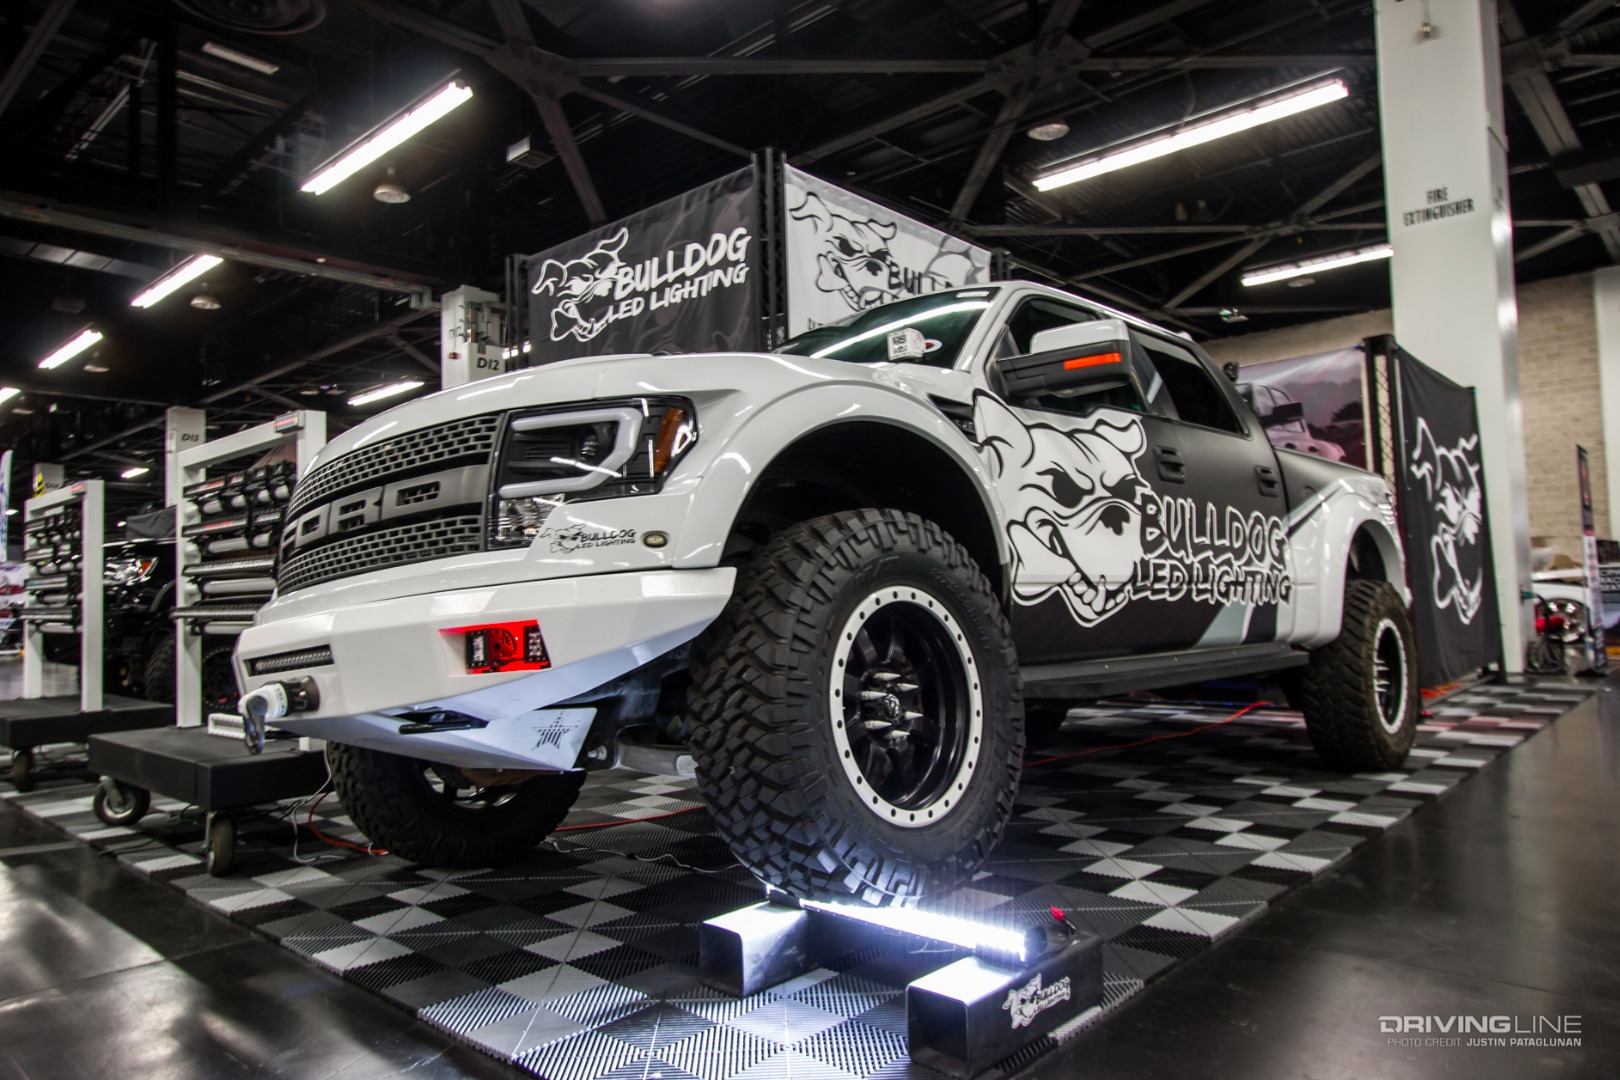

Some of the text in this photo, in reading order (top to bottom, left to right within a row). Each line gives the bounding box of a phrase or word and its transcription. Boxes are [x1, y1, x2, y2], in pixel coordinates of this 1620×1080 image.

[1403, 198, 1475, 227] EXTINGUISHER
[1427, 187, 1448, 204] FIRE
[614, 227, 752, 300] BULLDOG
[600, 263, 750, 325] LED LIGHTING
[477, 357, 500, 371] D12
[280, 466, 462, 558] FORD
[1136, 487, 1290, 567] BULLDOG
[580, 529, 637, 542] BULLDOG
[595, 538, 636, 547] LIGHTING
[1126, 559, 1295, 607] LED LIGHTING
